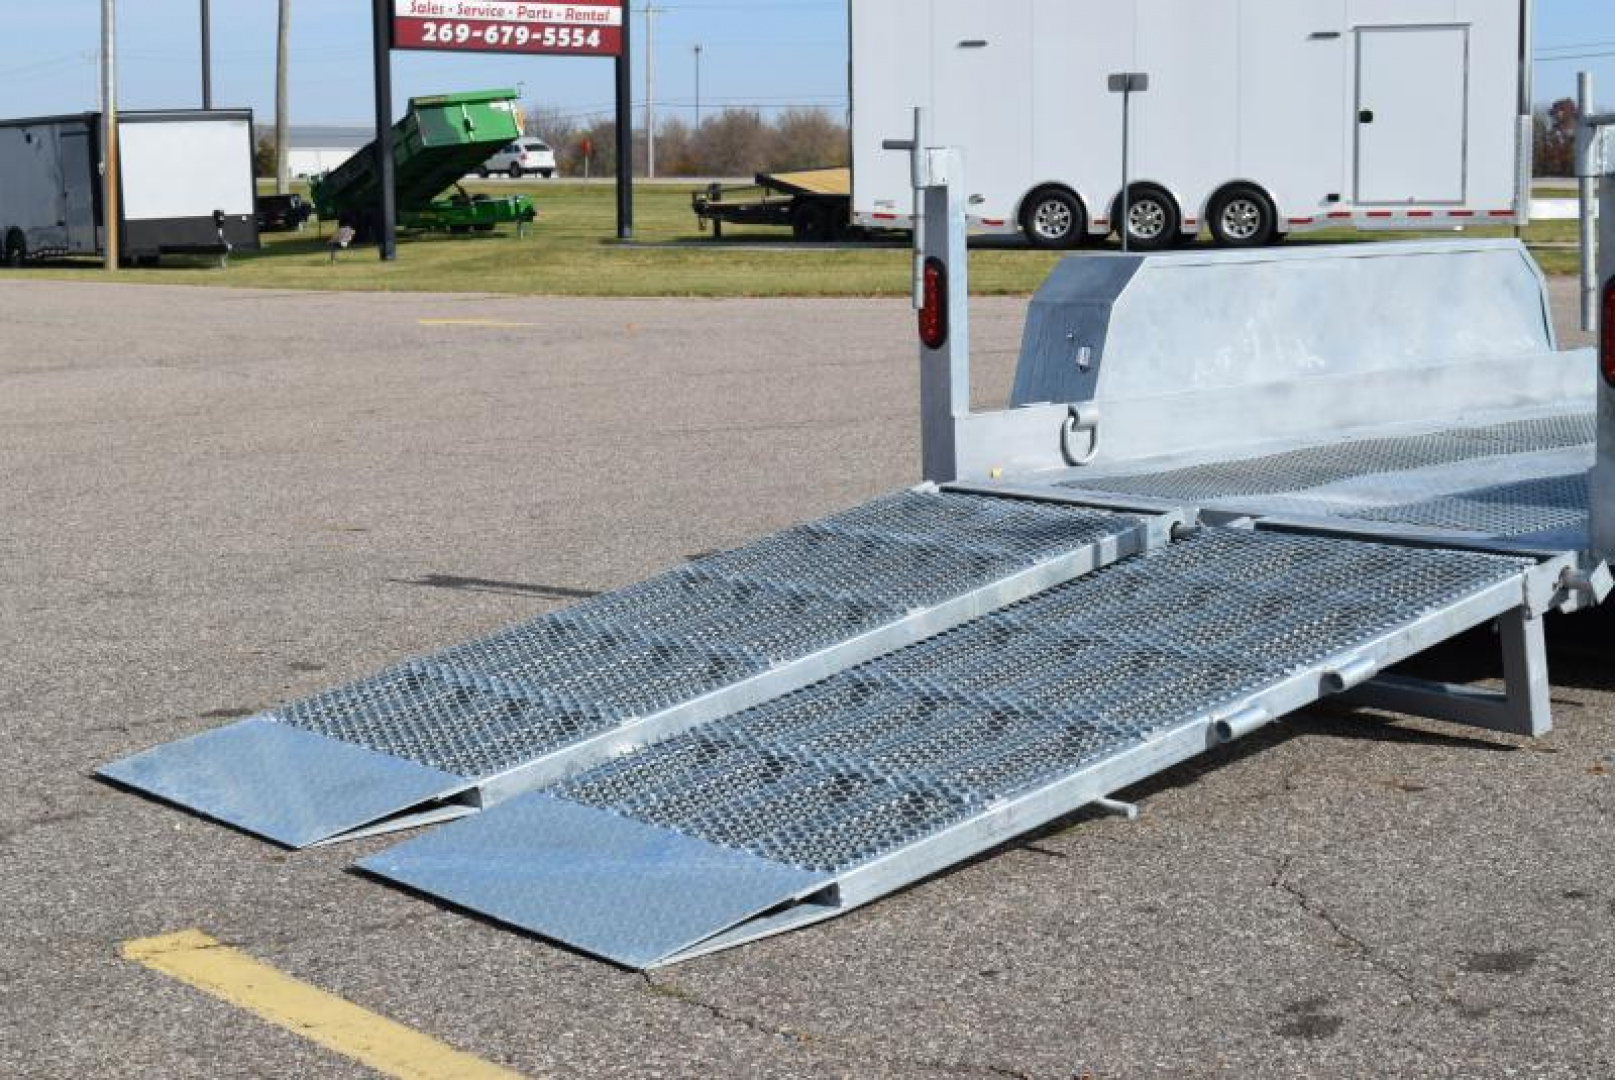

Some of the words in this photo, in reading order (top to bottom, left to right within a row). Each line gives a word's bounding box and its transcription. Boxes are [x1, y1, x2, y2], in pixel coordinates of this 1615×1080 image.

[410, 0, 445, 14] Sales
[457, 2, 505, 17] Service
[516, 6, 553, 19] Parts
[564, 8, 610, 21] Rental
[421, 21, 601, 48] 269-679-5554
